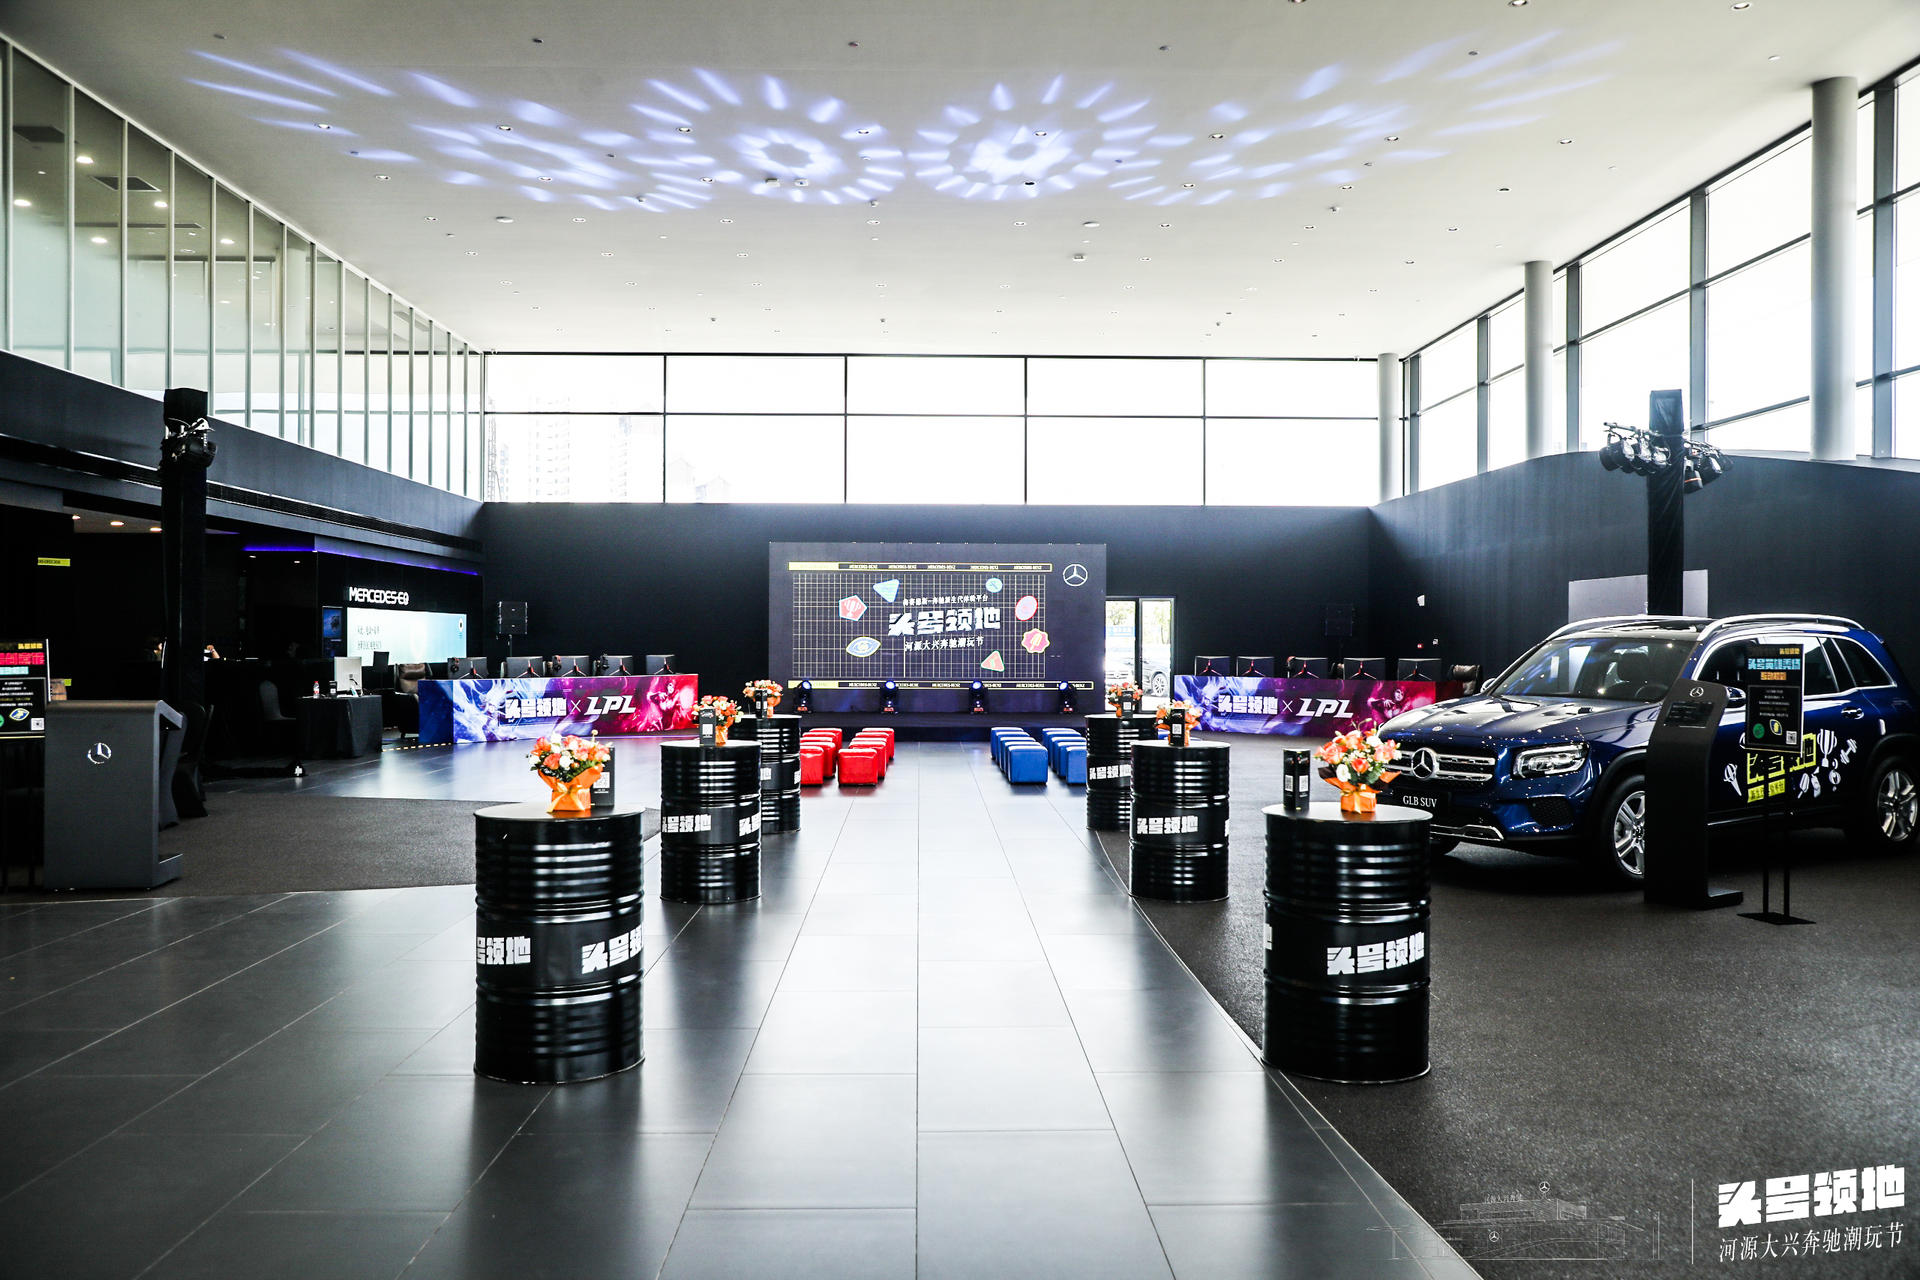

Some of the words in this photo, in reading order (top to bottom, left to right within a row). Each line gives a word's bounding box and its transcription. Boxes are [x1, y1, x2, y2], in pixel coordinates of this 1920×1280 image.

[887, 606, 1001, 636] 头号领地
[504, 697, 567, 719] 头号领地
[583, 695, 637, 716] LPL
[1217, 695, 1278, 715] 头号领地
[1295, 697, 1354, 719] LPL
[1402, 795, 1419, 806] GLB
[1420, 797, 1437, 808] SUV
[1136, 815, 1199, 835] 头号领地
[1327, 931, 1425, 976] 头号领地
